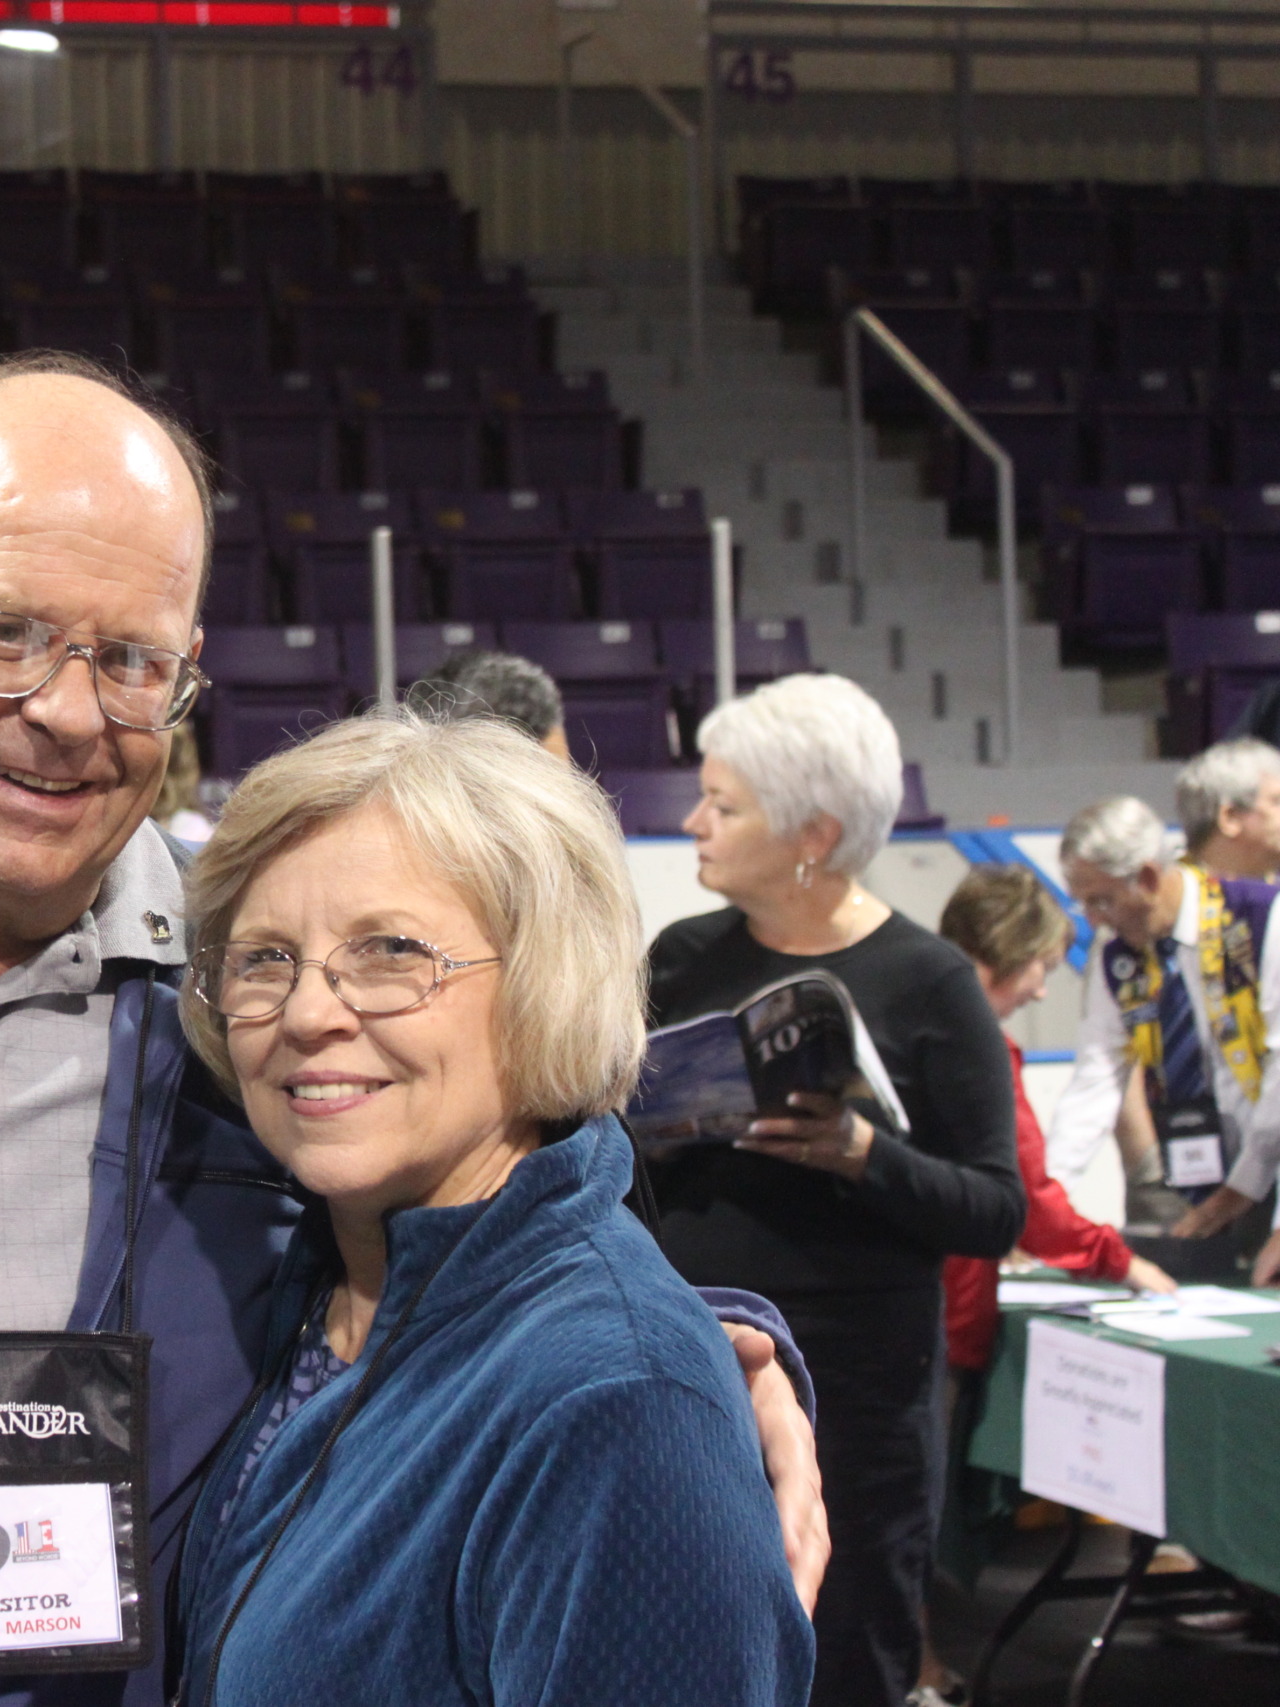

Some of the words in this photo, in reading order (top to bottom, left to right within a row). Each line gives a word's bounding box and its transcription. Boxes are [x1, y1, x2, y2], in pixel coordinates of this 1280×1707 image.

[341, 43, 418, 97] 44
[725, 48, 796, 103] 45
[6, 1616, 81, 1635] MARSON
